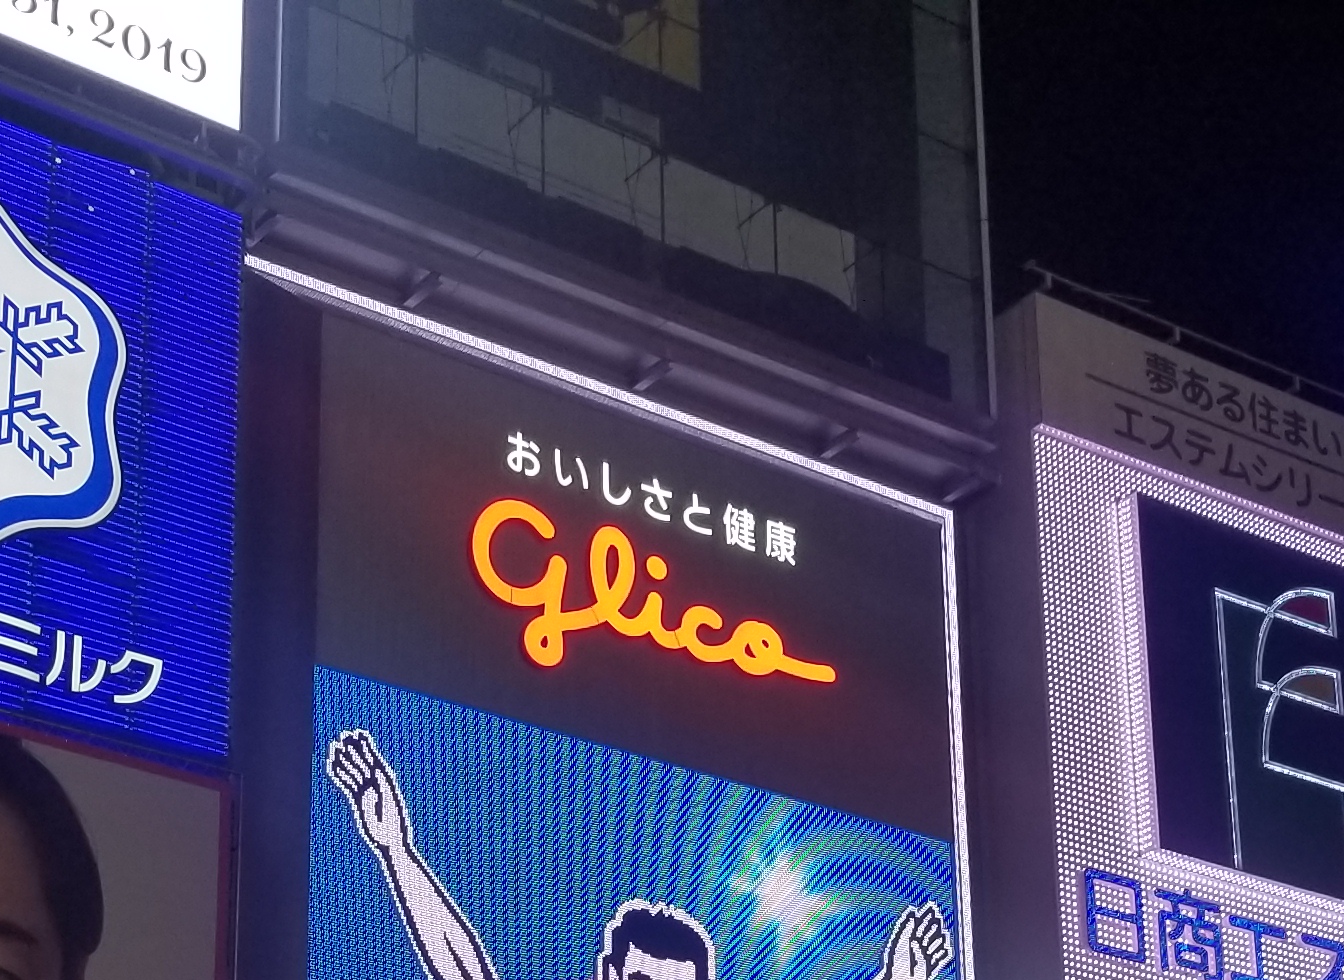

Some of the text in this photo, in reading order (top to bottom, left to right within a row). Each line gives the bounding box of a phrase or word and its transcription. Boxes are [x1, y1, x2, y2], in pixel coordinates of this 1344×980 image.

[89, 8, 207, 83] 2019
[1143, 350, 1343, 460] 夢ある住まい
[507, 431, 798, 566] おいしさと健康
[472, 498, 837, 685] Glico
